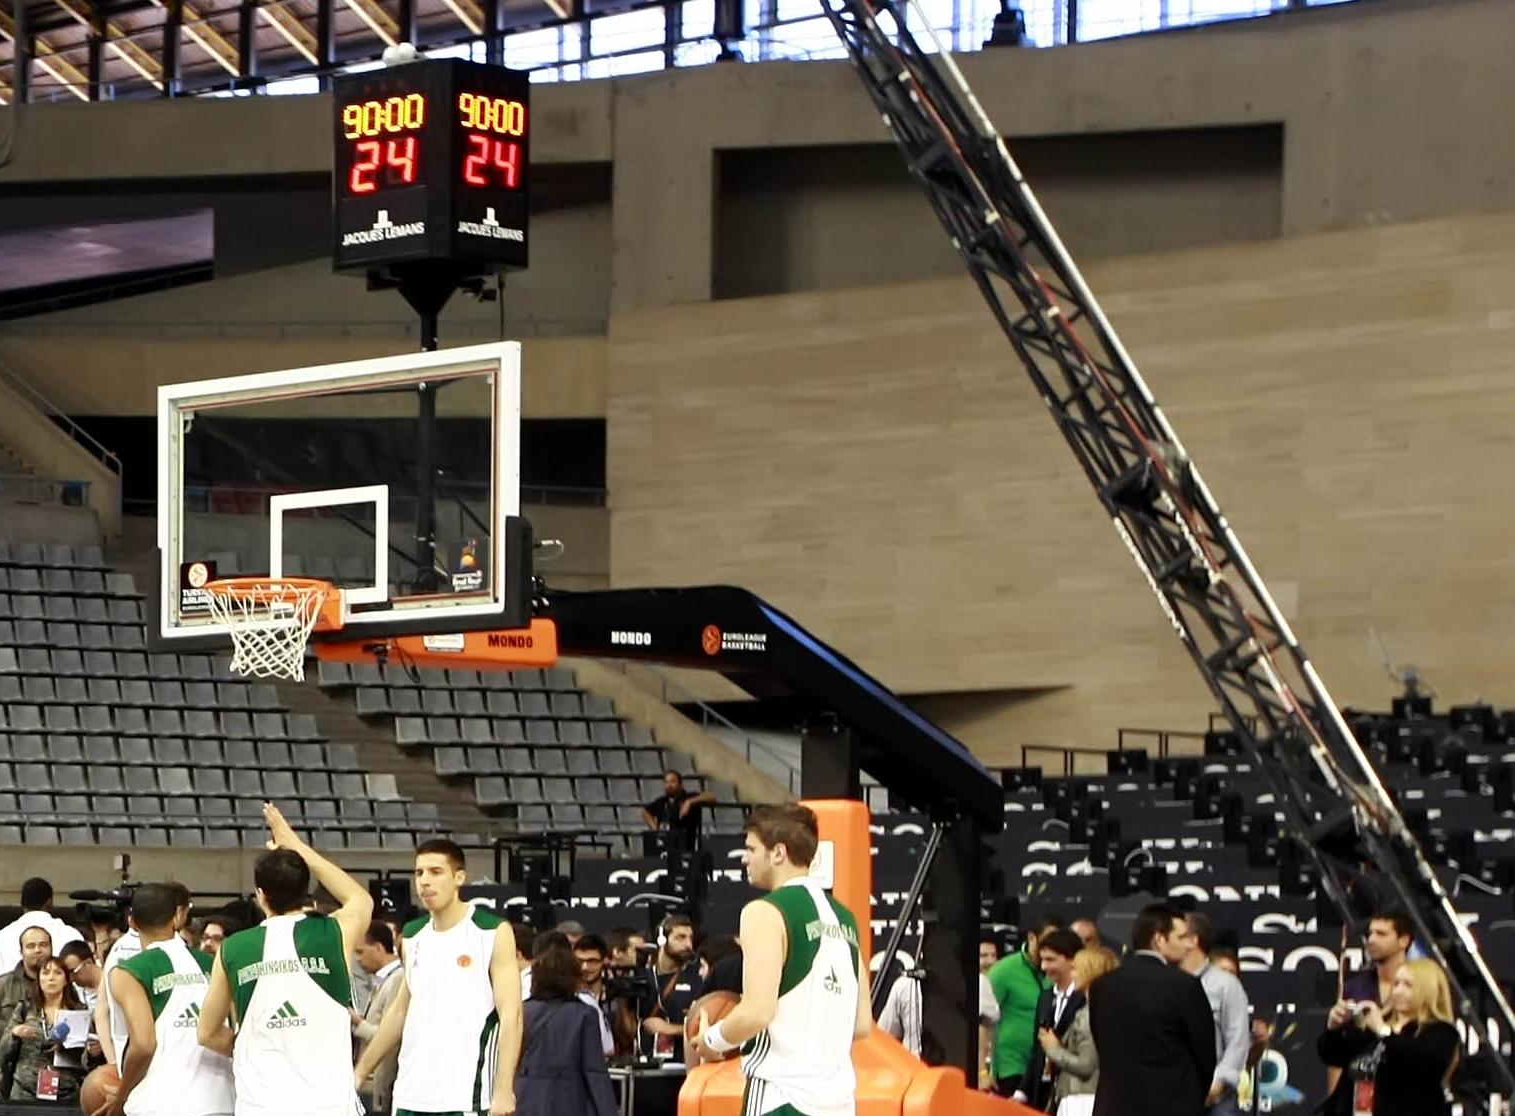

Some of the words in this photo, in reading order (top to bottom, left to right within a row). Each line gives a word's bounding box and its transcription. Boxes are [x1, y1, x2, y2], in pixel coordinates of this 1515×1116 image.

[343, 93, 424, 139] 90:00
[459, 92, 524, 136] 90:00
[350, 136, 416, 194] 24
[464, 134, 519, 189] 24
[342, 227, 385, 246] JACQUES
[385, 221, 425, 240] LEMANS
[457, 220, 492, 237] JACQUES
[487, 634, 533, 648] MONDO
[610, 630, 652, 646] MONDO
[266, 1018, 307, 1030] adidas
